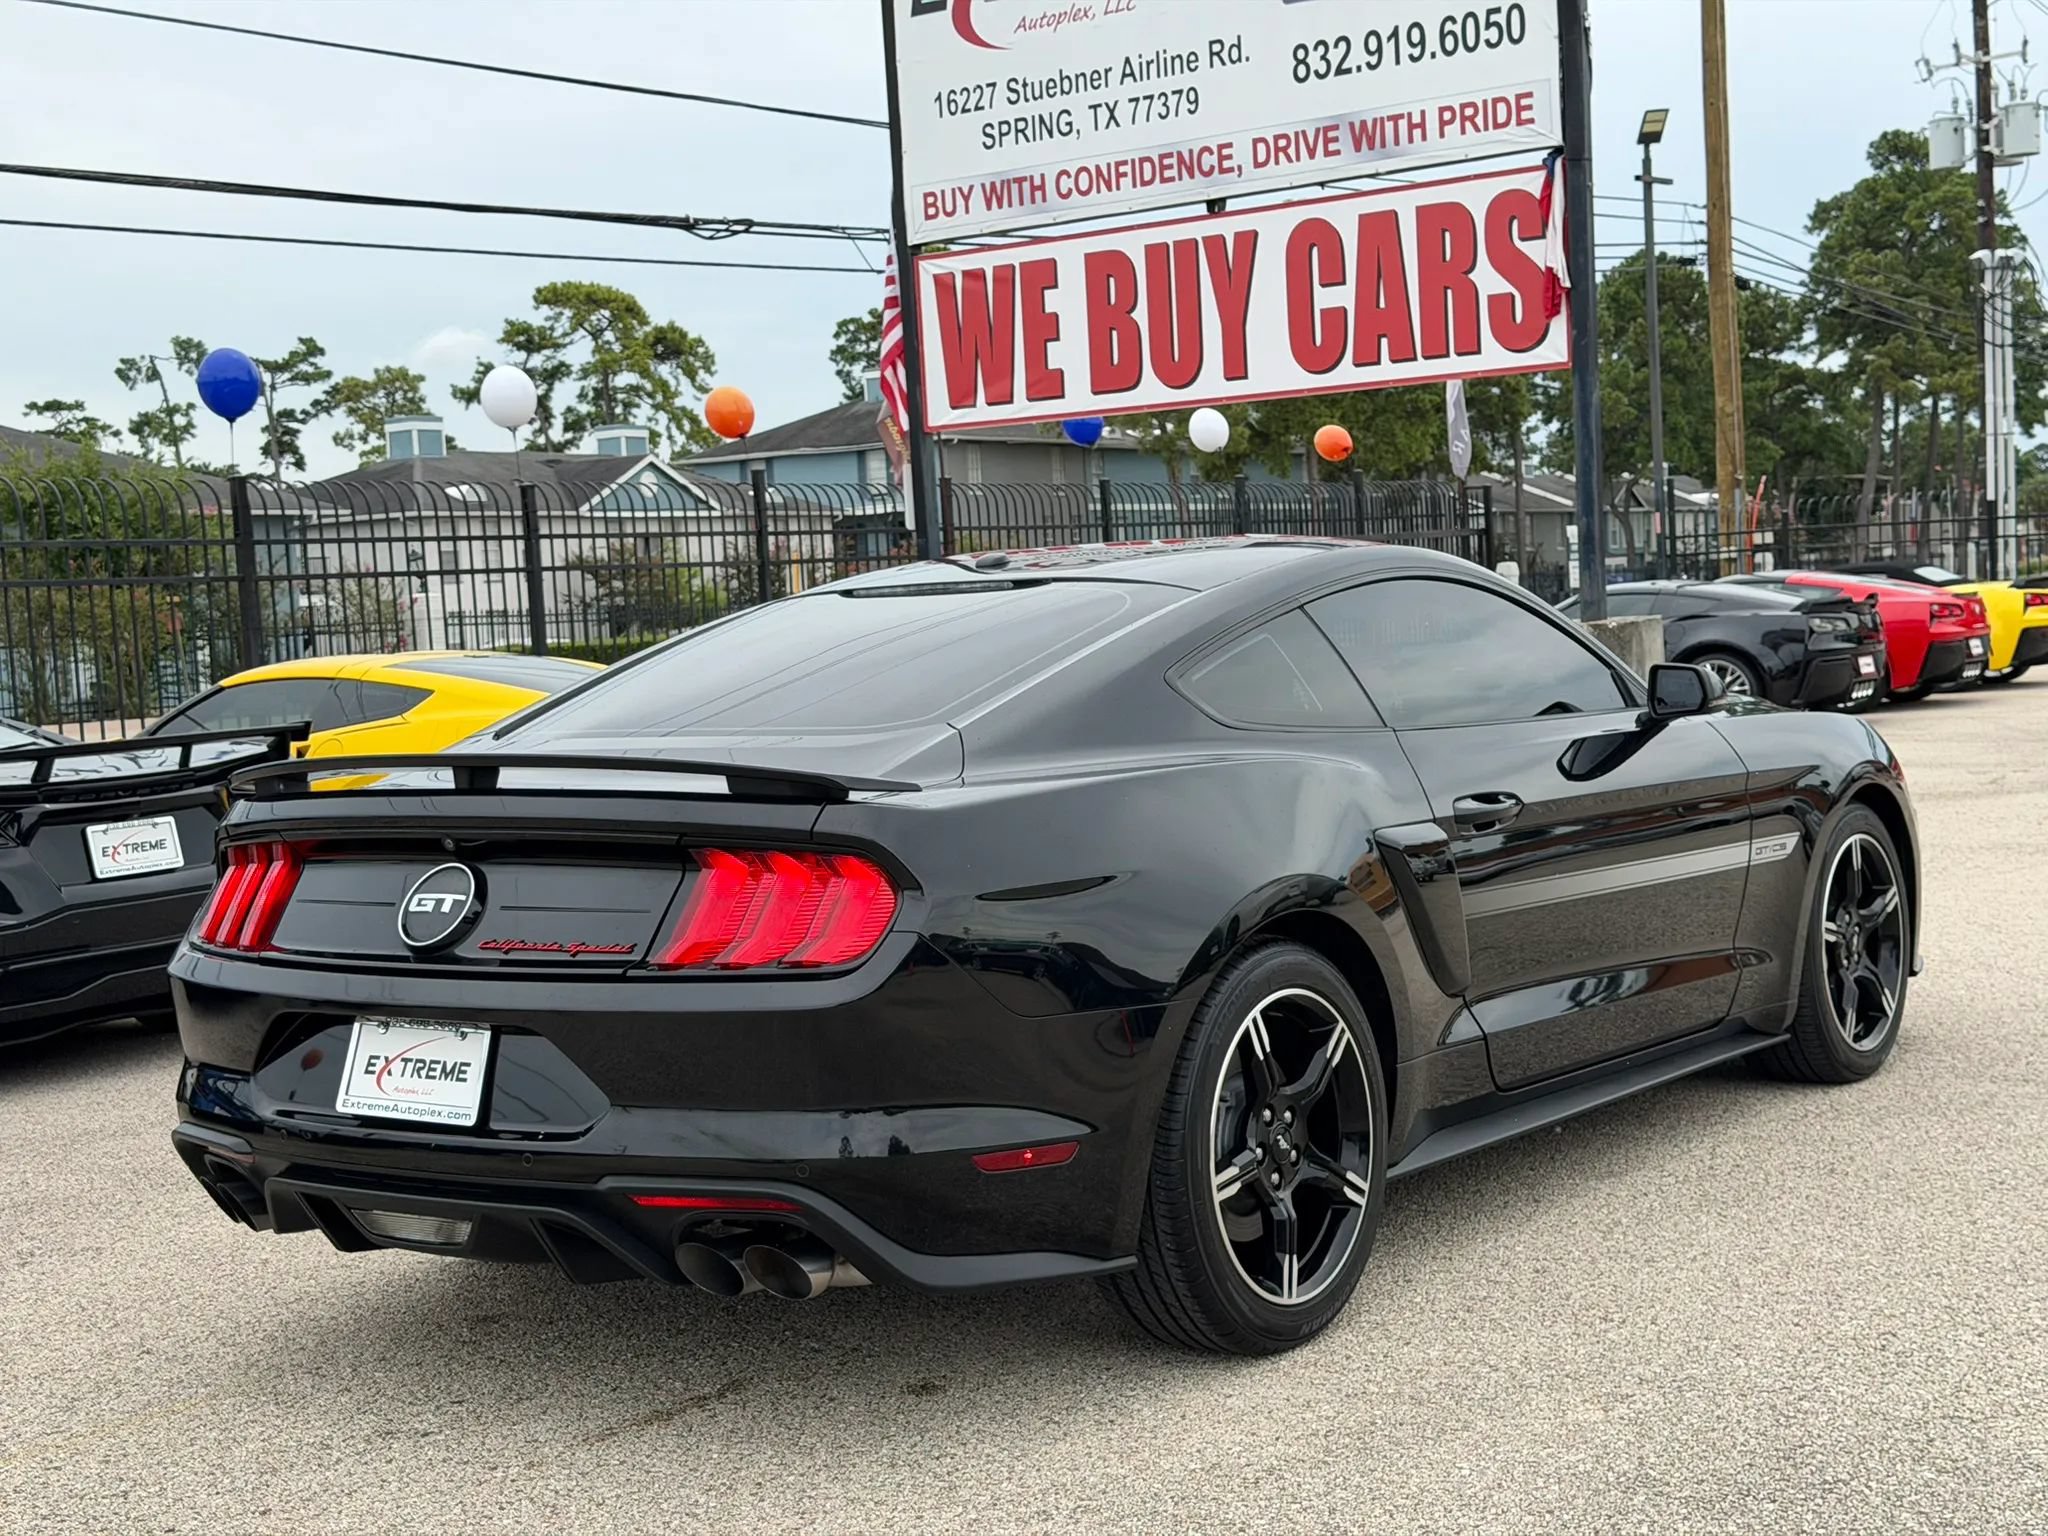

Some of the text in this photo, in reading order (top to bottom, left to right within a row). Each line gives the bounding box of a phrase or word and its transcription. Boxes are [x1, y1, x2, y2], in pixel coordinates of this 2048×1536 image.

[1012, 2, 1097, 34] Autoplex,
[1291, 2, 1526, 84] 832.919.6050
[934, 34, 1251, 119] 16227 Stuebner Airline Rd.
[981, 86, 1200, 151] SPRING, TX 77379
[922, 90, 1536, 222] BUY WITH CONFIDENCE, DRIVE WITH PRIDE
[932, 187, 1553, 411] WE BUY CARS
[101, 838, 168, 859] EXTREME
[408, 892, 468, 914] GT
[363, 1054, 473, 1084] EXTREME
[341, 1098, 473, 1122] ExtremeAutoplex.com
